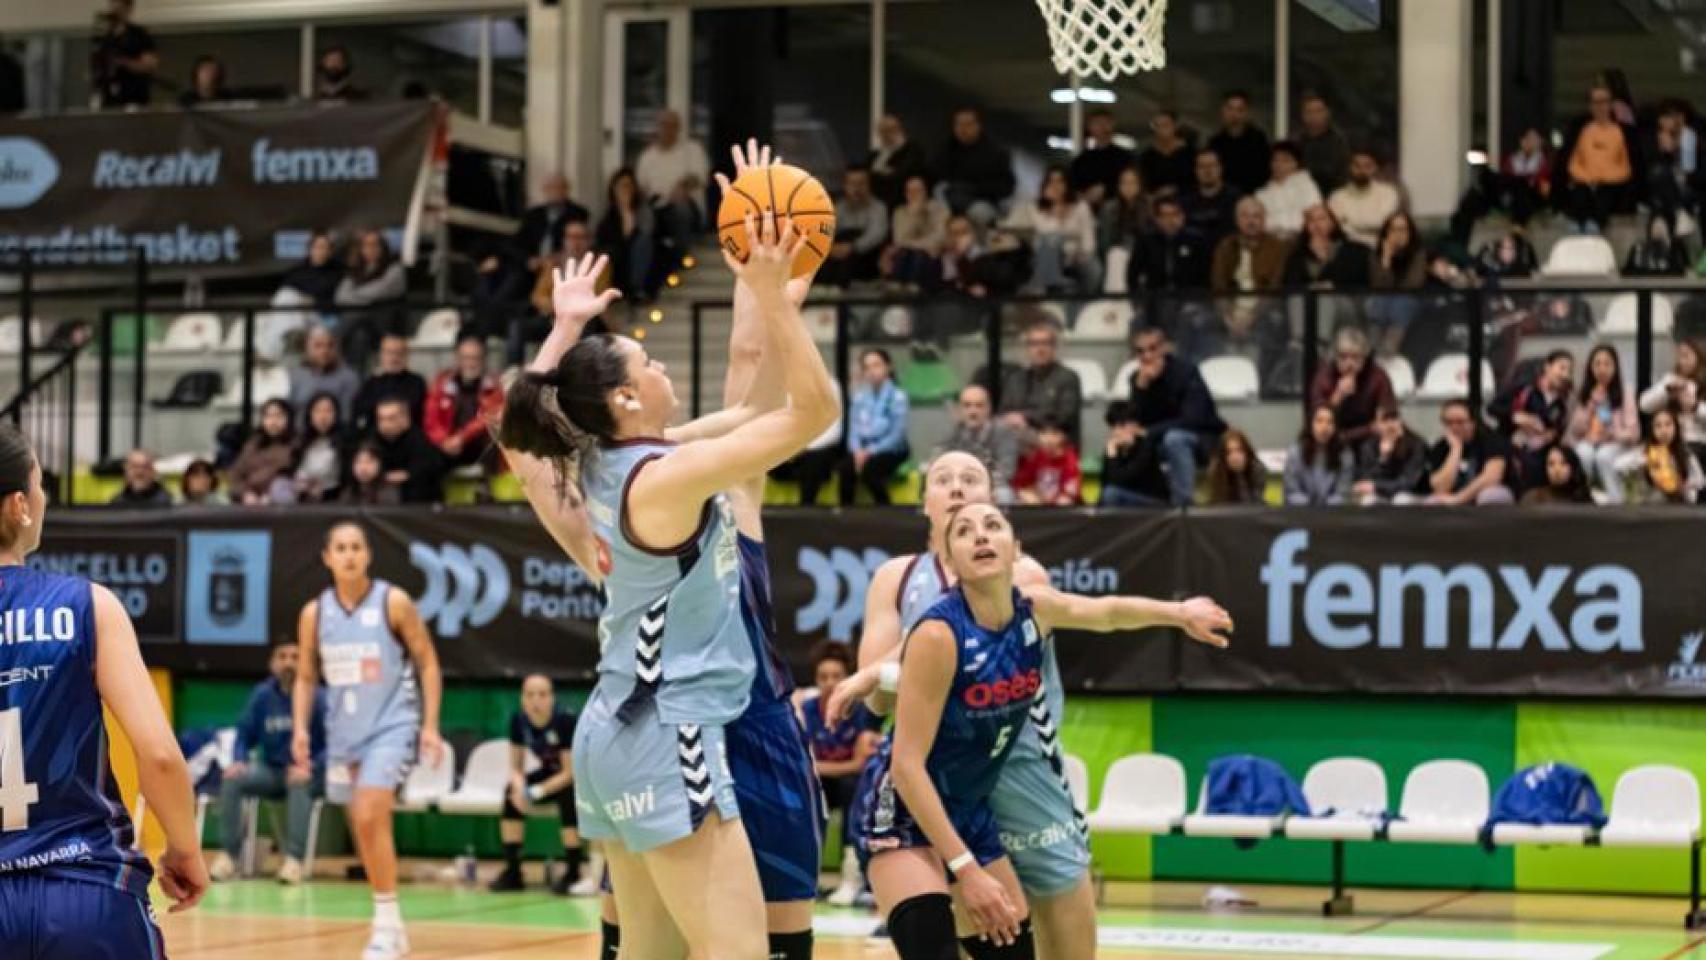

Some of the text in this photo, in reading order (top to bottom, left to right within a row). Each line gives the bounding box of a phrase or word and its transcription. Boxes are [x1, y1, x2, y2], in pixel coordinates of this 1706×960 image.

[93, 150, 222, 189] Recalvi
[251, 138, 380, 184] femxa
[1260, 528, 1645, 652] femxa
[0, 606, 76, 646] ILLO
[989, 723, 1014, 759] 5
[15, 841, 92, 870] NAVARRA
